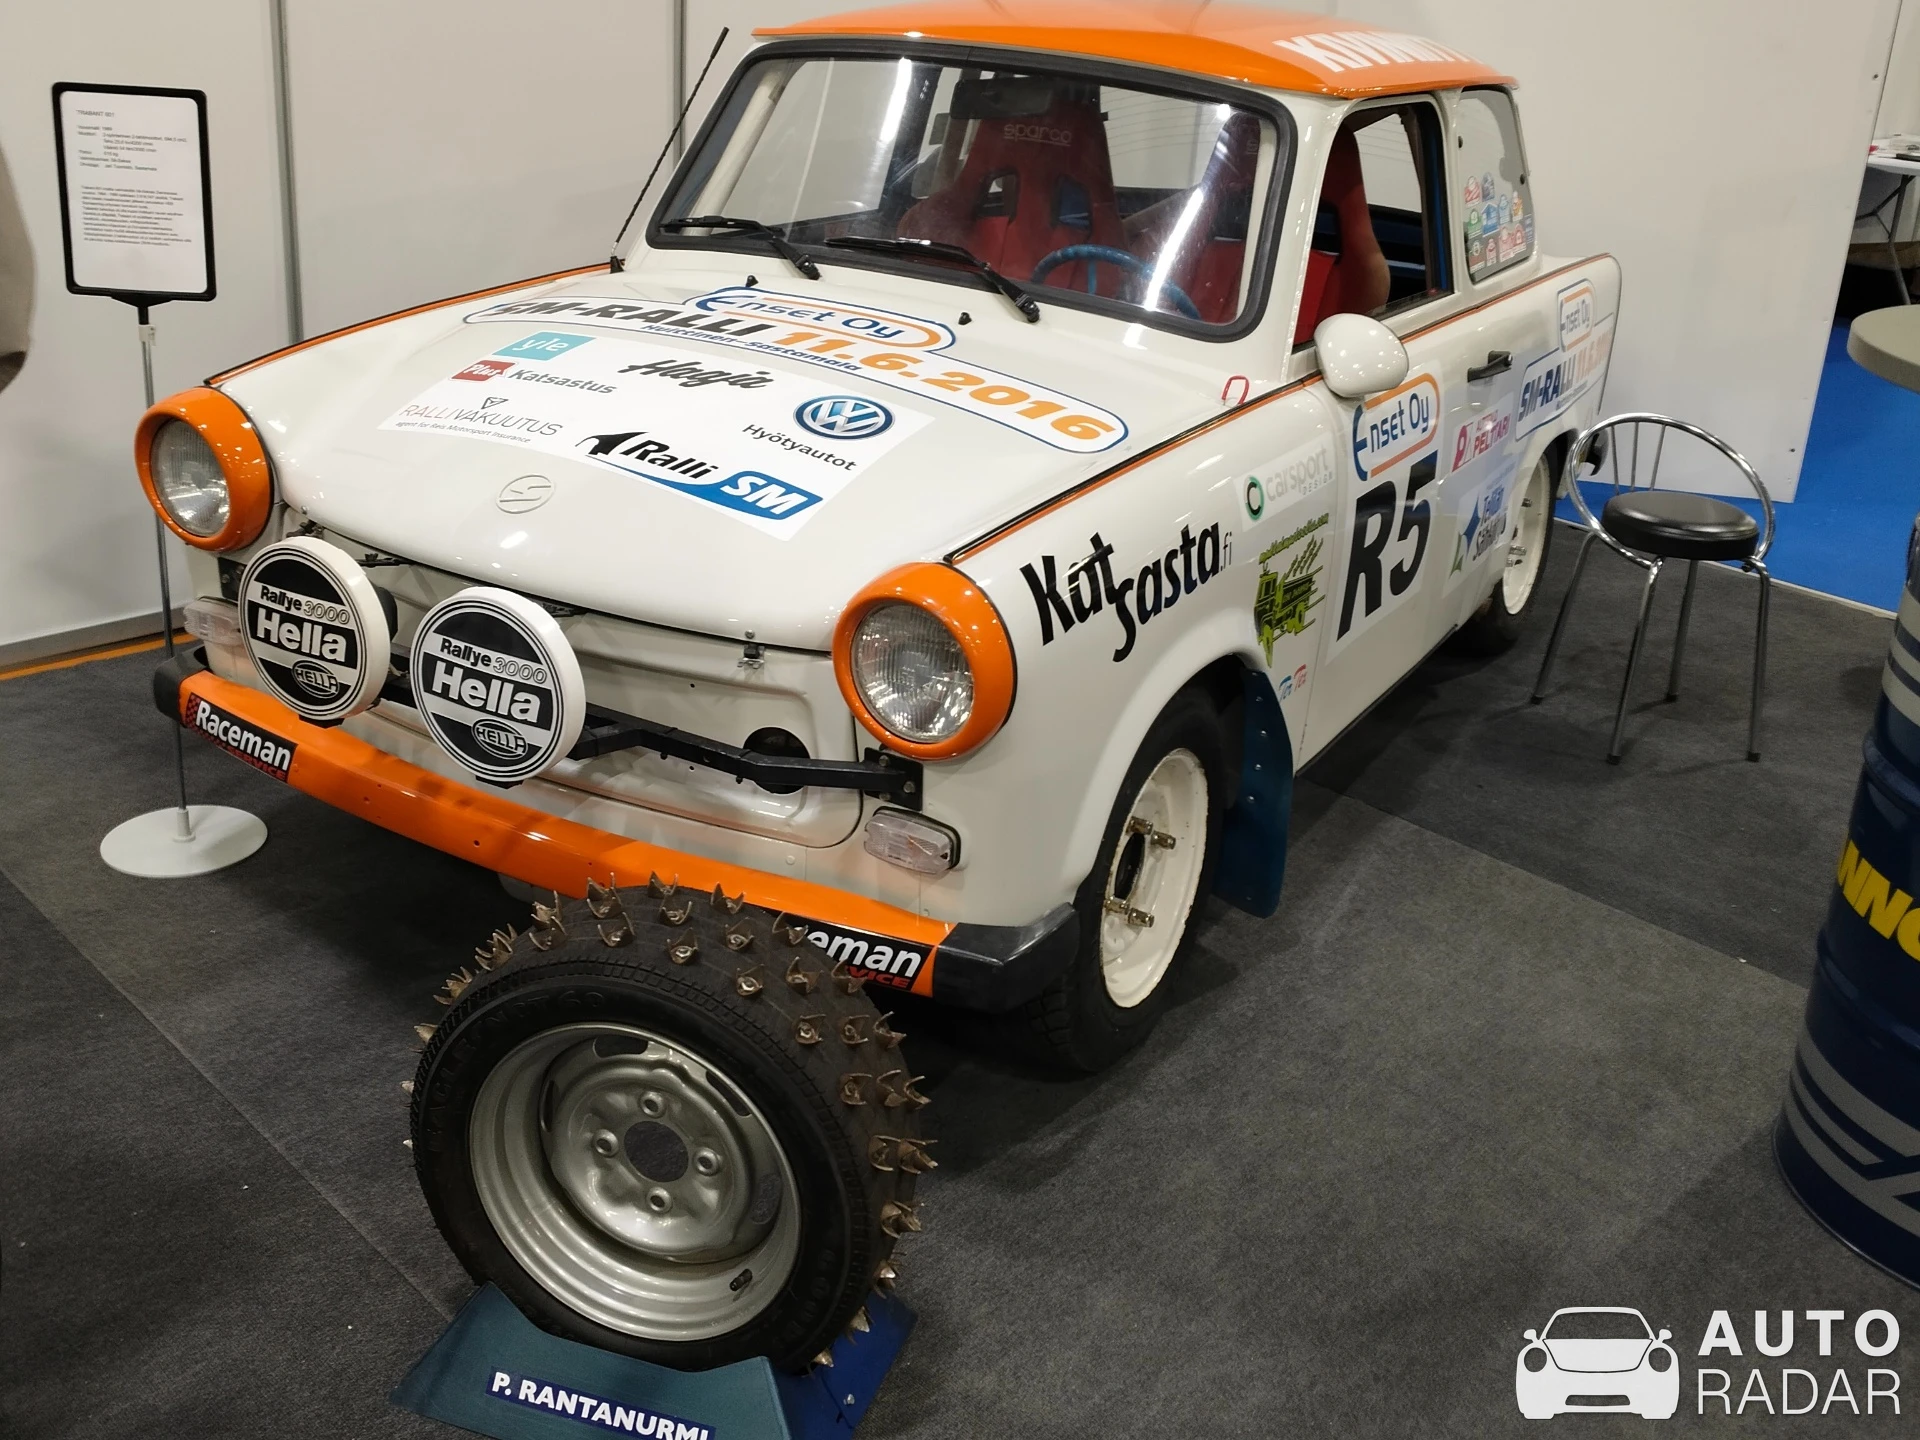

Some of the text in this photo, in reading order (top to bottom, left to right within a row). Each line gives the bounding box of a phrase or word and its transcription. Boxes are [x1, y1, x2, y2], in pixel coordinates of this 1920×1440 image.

[1003, 123, 1073, 145] sparco
[696, 295, 905, 339] Enset Oy
[512, 337, 569, 352] yle
[463, 364, 619, 394] Plus Katsastus
[478, 302, 1116, 440] SM-RALLI 11.6.2016
[1517, 354, 1577, 422] SM-RALLI
[398, 404, 563, 436] RALLIVAKUUTUS
[446, 425, 491, 435] Motorsport
[491, 431, 531, 443] Insurance
[1353, 392, 1429, 482] Enset Oy
[742, 424, 858, 471] Hyötyautot
[619, 439, 808, 515] Ralli SM
[1265, 447, 1328, 502] carsport
[1336, 449, 1438, 642] R5
[261, 585, 350, 624] Rallye 3000
[257, 607, 347, 662] Hella
[296, 669, 338, 693] HELLA
[440, 638, 547, 684] Rallye 3000
[432, 660, 541, 723] Hella
[196, 701, 291, 771] Raceman
[476, 727, 525, 753] HELLA
[797, 926, 921, 977] eman
[492, 1372, 512, 1396] P.
